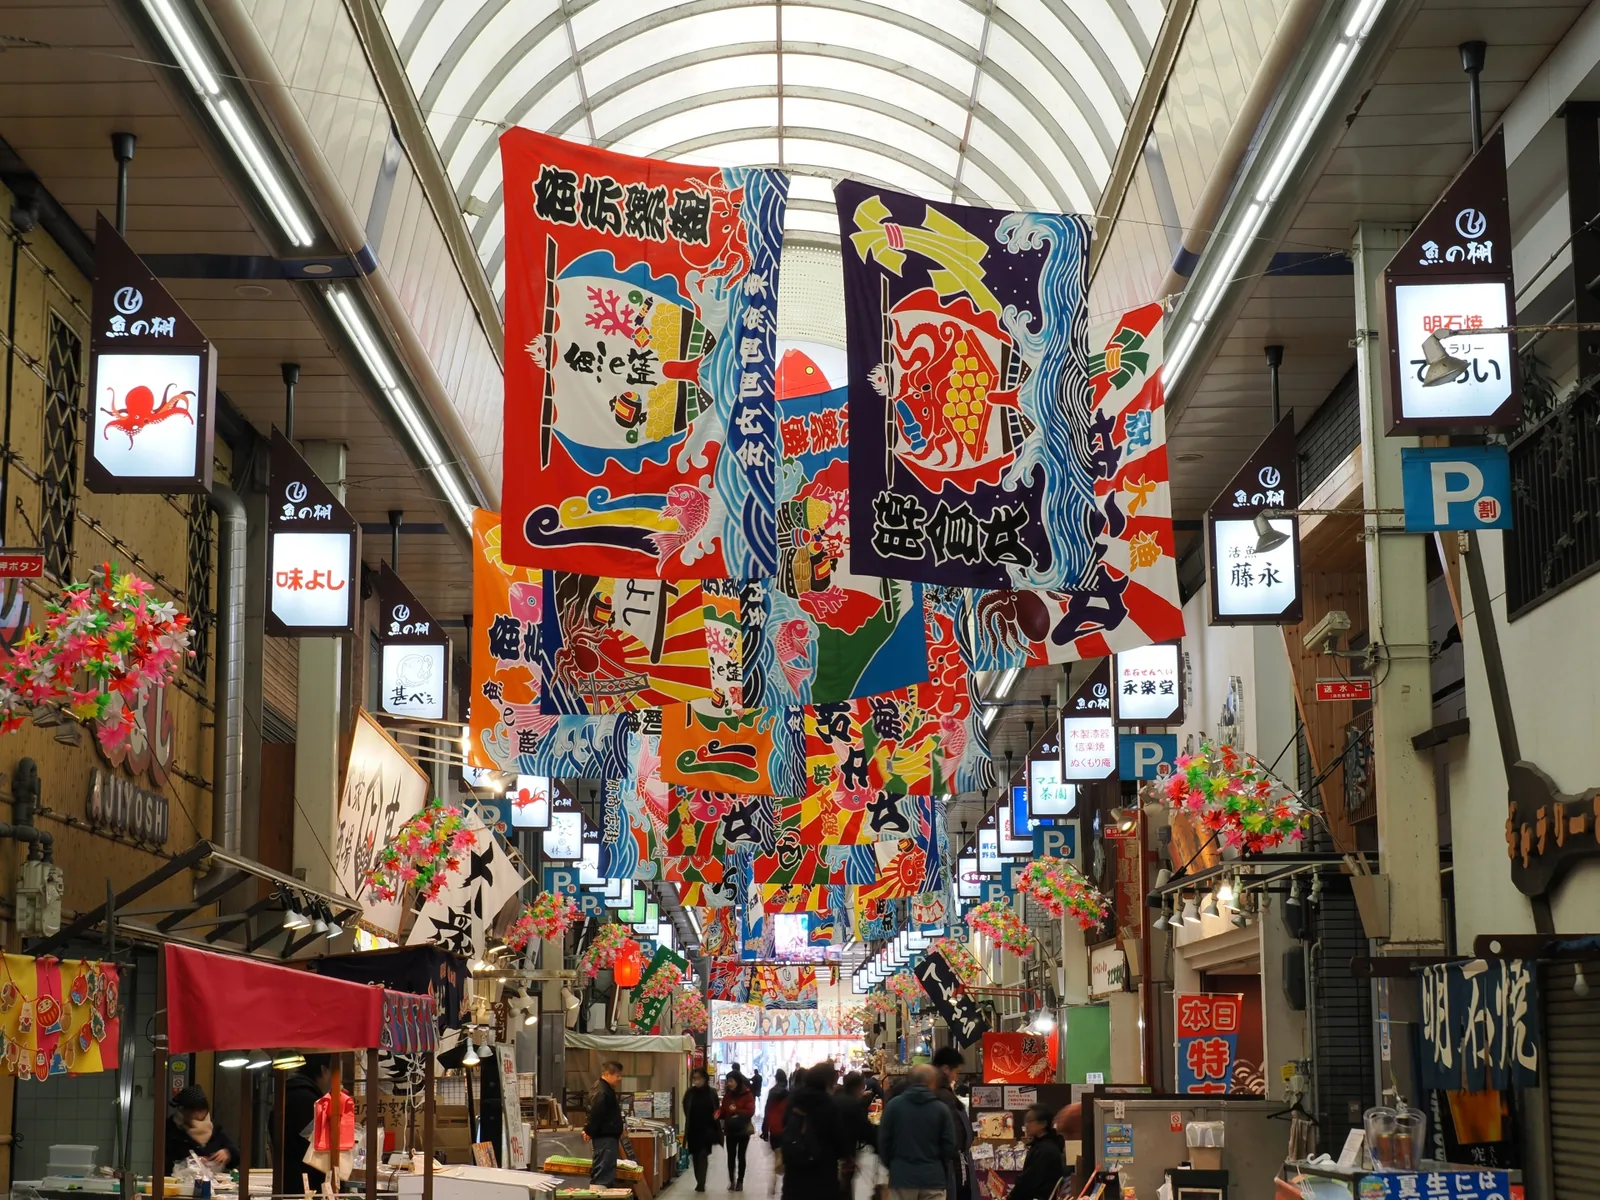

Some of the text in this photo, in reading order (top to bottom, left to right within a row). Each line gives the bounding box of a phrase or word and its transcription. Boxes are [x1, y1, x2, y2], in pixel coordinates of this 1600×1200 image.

[1419, 241, 1493, 265] 魚の棚
[106, 315, 176, 338] 魚の棚
[780, 400, 852, 458] 繁盛
[1122, 408, 1164, 573] 祝大漁
[1232, 490, 1285, 507] 魚の棚
[1430, 461, 1498, 526] P 割
[280, 504, 332, 521] 魚の棚
[1228, 545, 1258, 559] 活魚
[276, 567, 345, 592] 味よし
[1230, 562, 1283, 589] 藤永
[388, 621, 430, 636] 魚の棚
[1123, 679, 1175, 696] 永楽堂
[1323, 684, 1362, 693] 送水口
[1075, 698, 1110, 710] 魚の棚
[1070, 729, 1110, 740] 木製漆器
[1075, 742, 1106, 752] 信楽焼
[1135, 742, 1163, 778] P
[1040, 787, 1067, 800] 茶園
[92, 768, 169, 843] AJIYOSHI
[1043, 831, 1065, 857] P
[553, 871, 572, 895] P
[988, 884, 1003, 902] P
[581, 895, 598, 915] P
[950, 926, 963, 942] P
[1181, 1000, 1236, 1031] 本日
[1421, 959, 1538, 1072] 明石焼
[1187, 1036, 1231, 1094] 特
